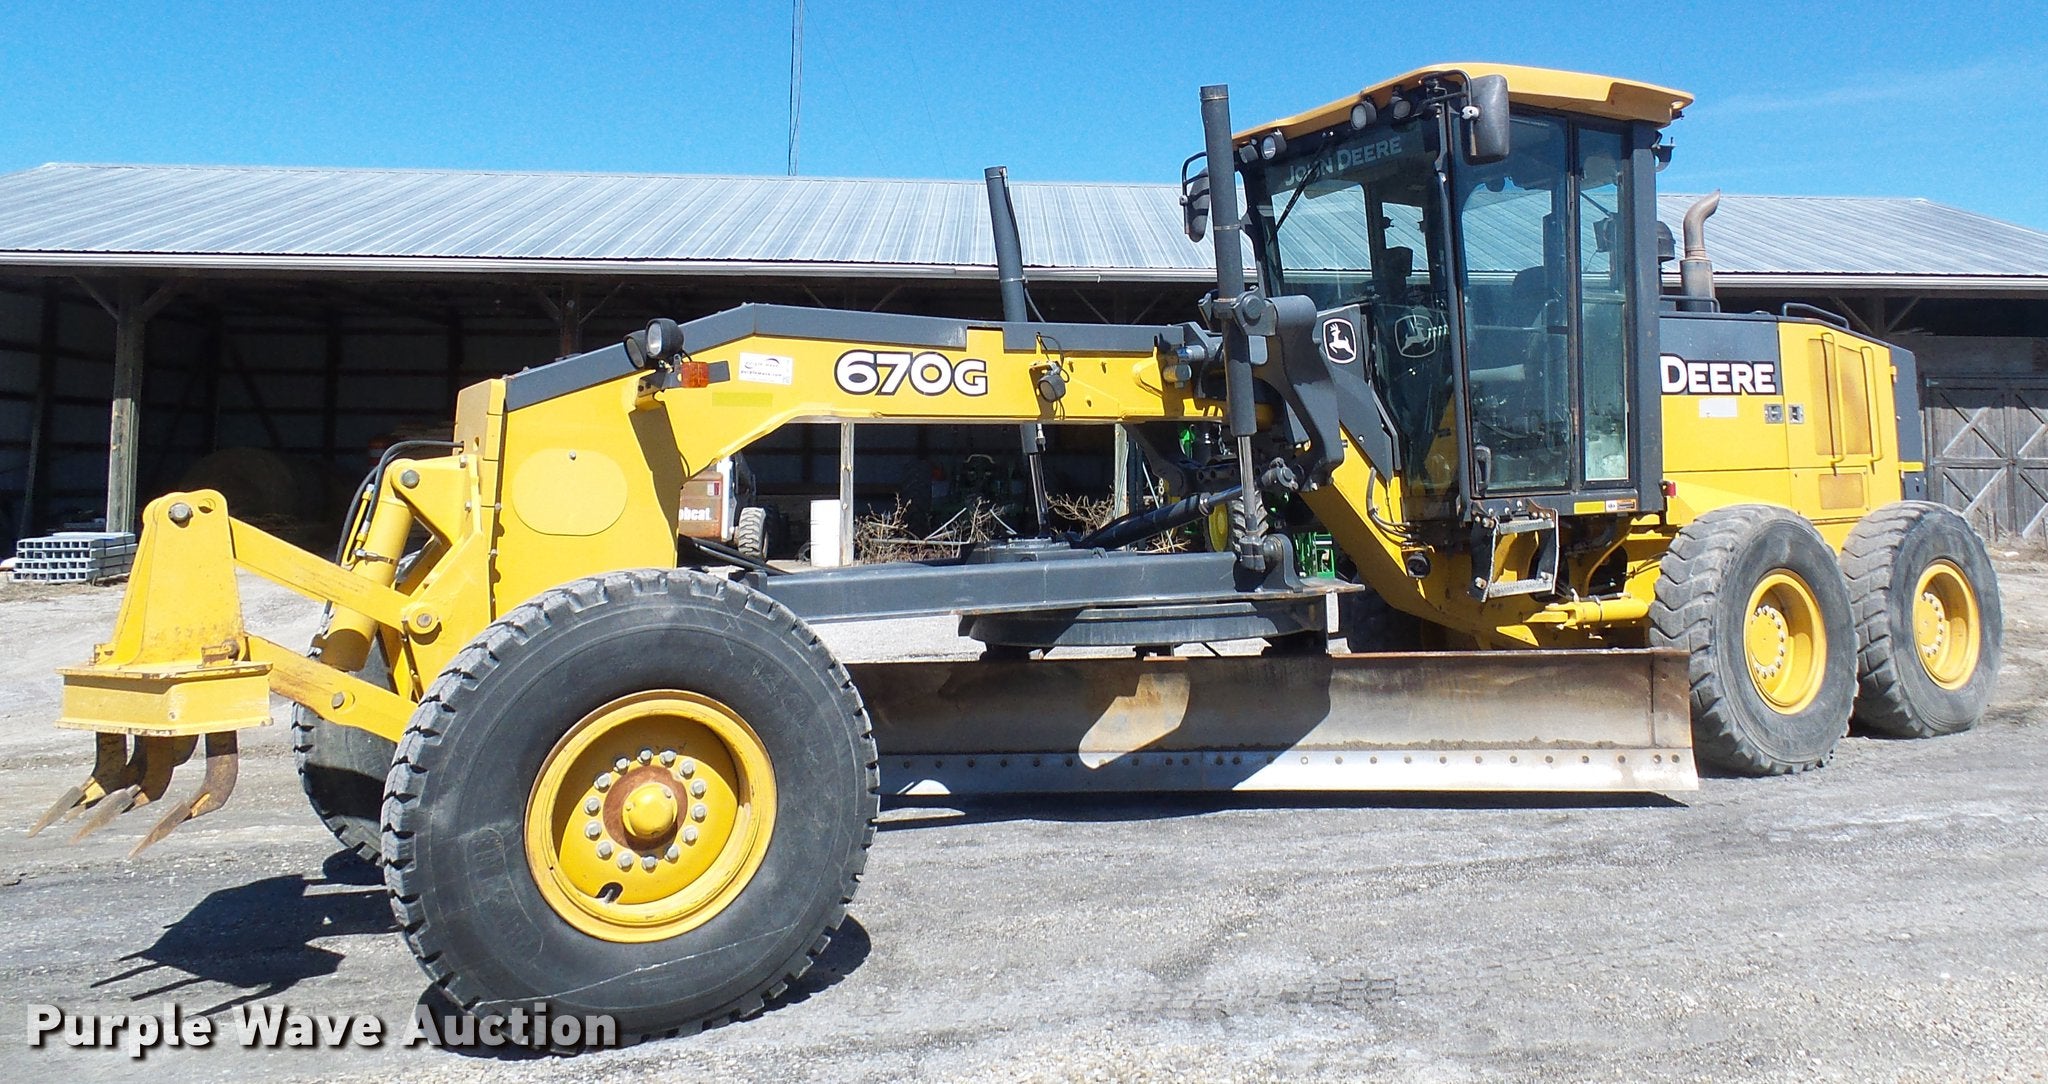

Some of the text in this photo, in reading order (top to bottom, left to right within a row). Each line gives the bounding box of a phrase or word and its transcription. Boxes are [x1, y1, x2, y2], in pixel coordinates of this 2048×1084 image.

[1337, 136, 1403, 172] DEERE
[834, 349, 988, 397] 670G
[1660, 352, 1776, 395] DEERE
